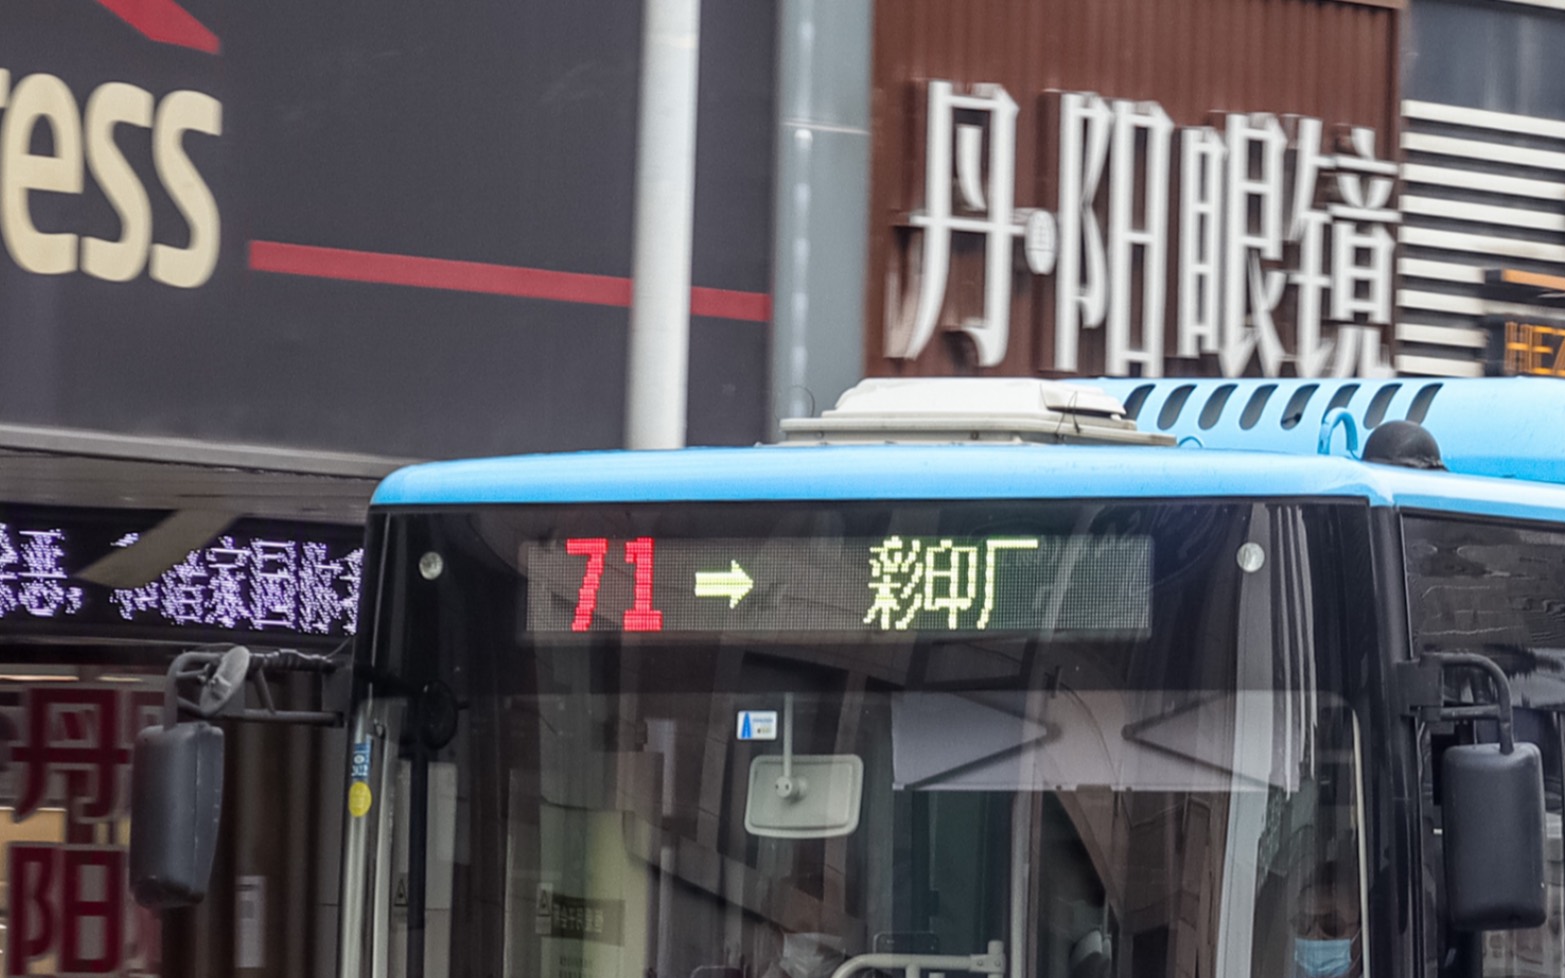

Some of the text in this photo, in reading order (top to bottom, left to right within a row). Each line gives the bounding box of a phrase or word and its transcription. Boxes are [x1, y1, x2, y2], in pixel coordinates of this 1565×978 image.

[0, 68, 222, 289] ess
[566, 536, 1038, 631] 71 彩印厂
